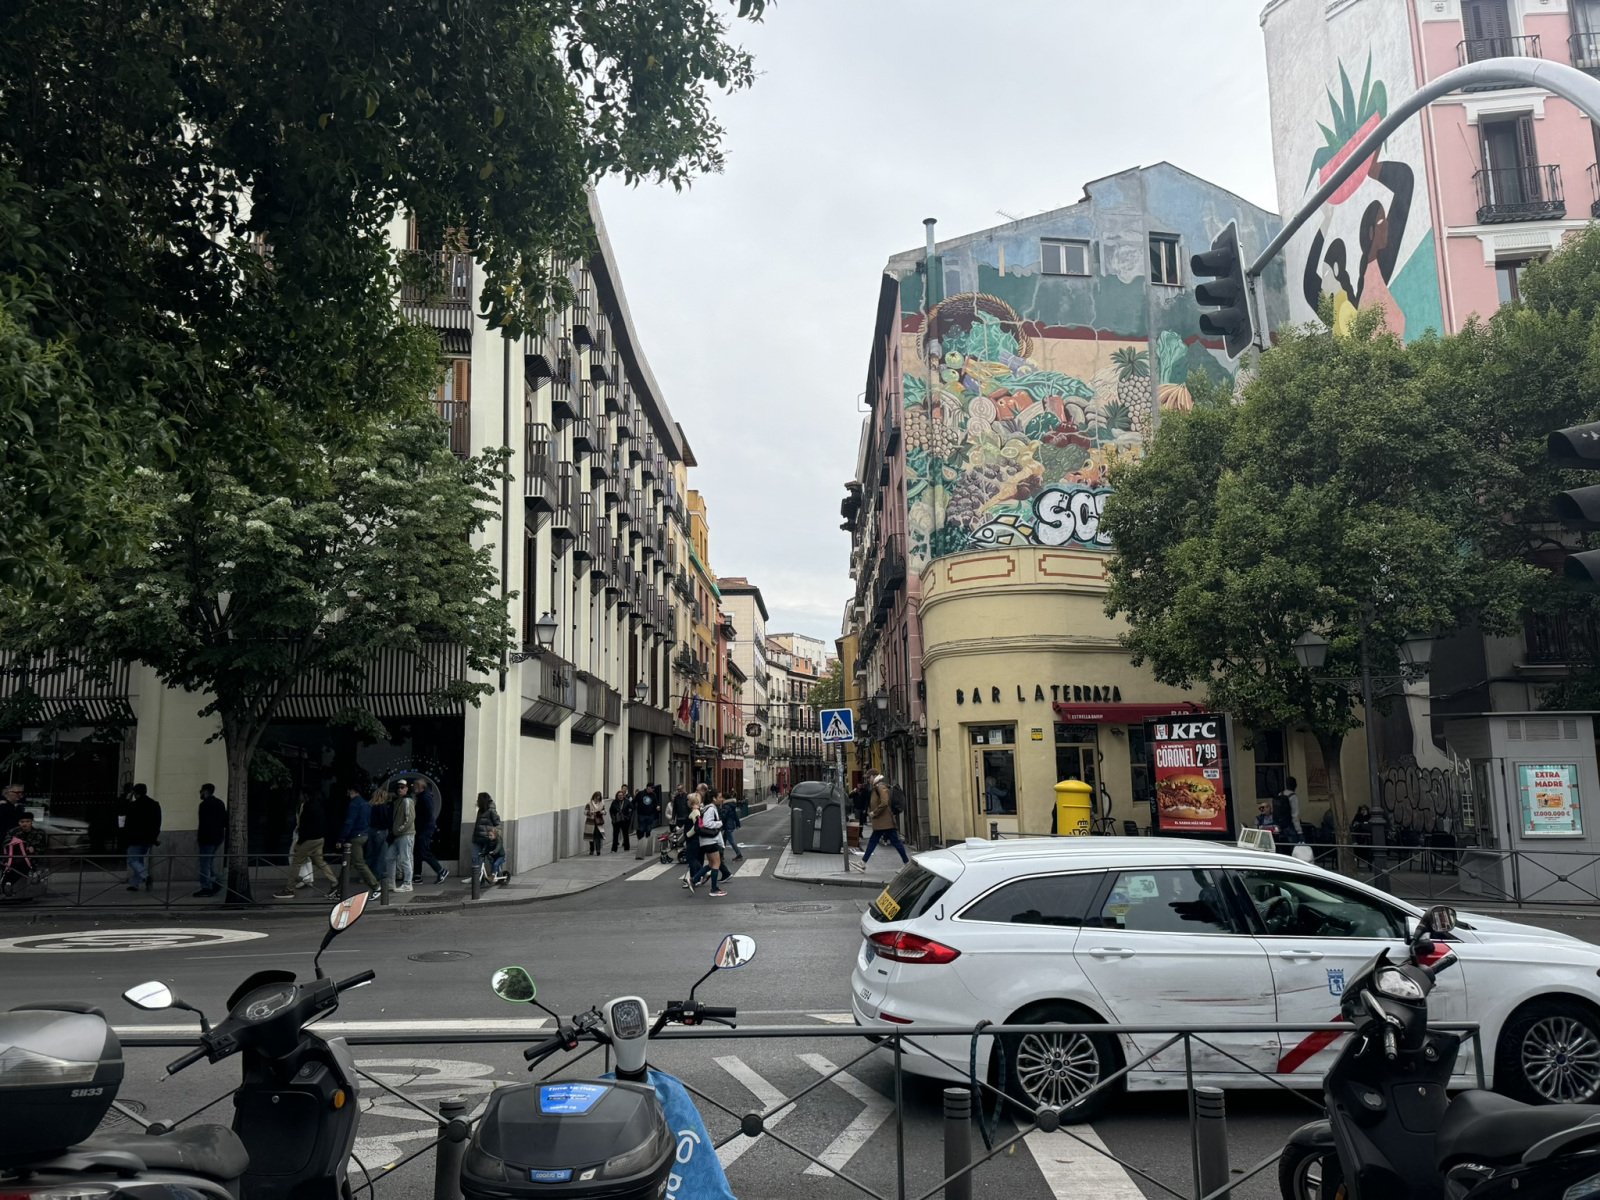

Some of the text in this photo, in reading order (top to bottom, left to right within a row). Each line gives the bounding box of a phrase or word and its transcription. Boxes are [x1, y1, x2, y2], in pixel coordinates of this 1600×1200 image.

[956, 683, 1122, 706] BAR LA TERRAZA
[1170, 721, 1217, 740] KFC
[1156, 748, 1196, 768] CORONEL
[71, 1087, 104, 1098] SH33
